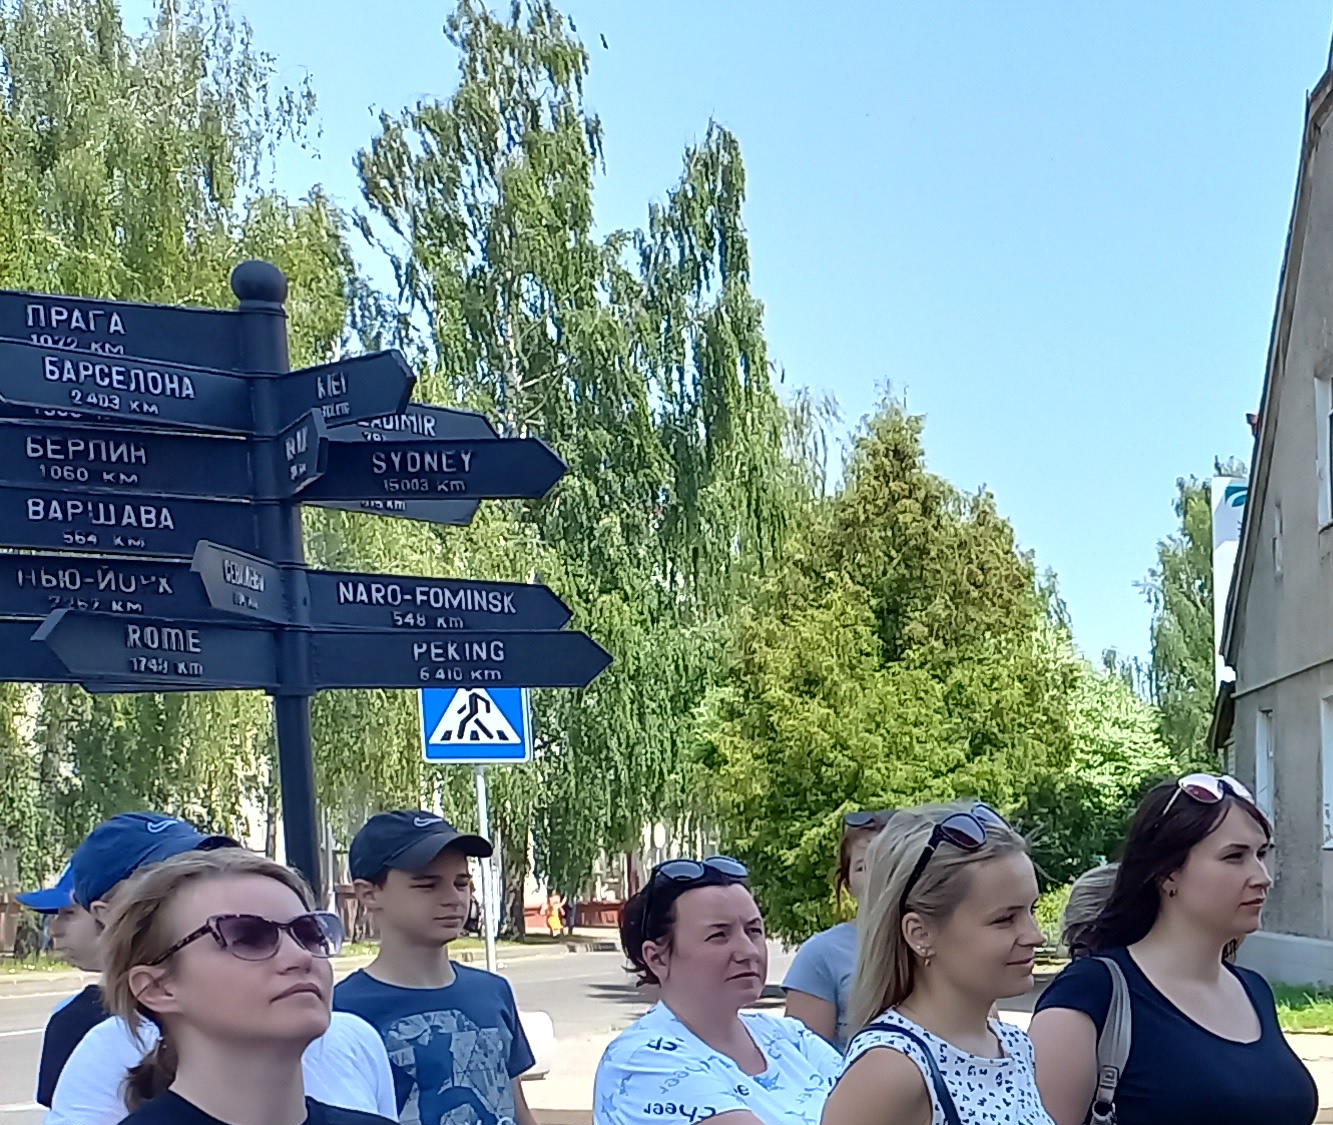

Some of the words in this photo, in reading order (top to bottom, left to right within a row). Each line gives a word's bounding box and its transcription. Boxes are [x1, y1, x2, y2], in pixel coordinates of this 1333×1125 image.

[26, 304, 127, 335] ПРАГА
[43, 355, 196, 399] БАРСЕЛОНА
[26, 436, 147, 465] БЕРЛИН
[372, 450, 473, 474] SYDNEY
[40, 463, 89, 482] 1060
[383, 478, 429, 492] 15003
[27, 498, 175, 530] ВАРШАВА
[63, 530, 98, 545] 564
[338, 582, 517, 614] NARO-FOMINSK
[392, 611, 427, 627] 548
[413, 641, 505, 662] PEKING
[643, 1102, 718, 1124] cheer
